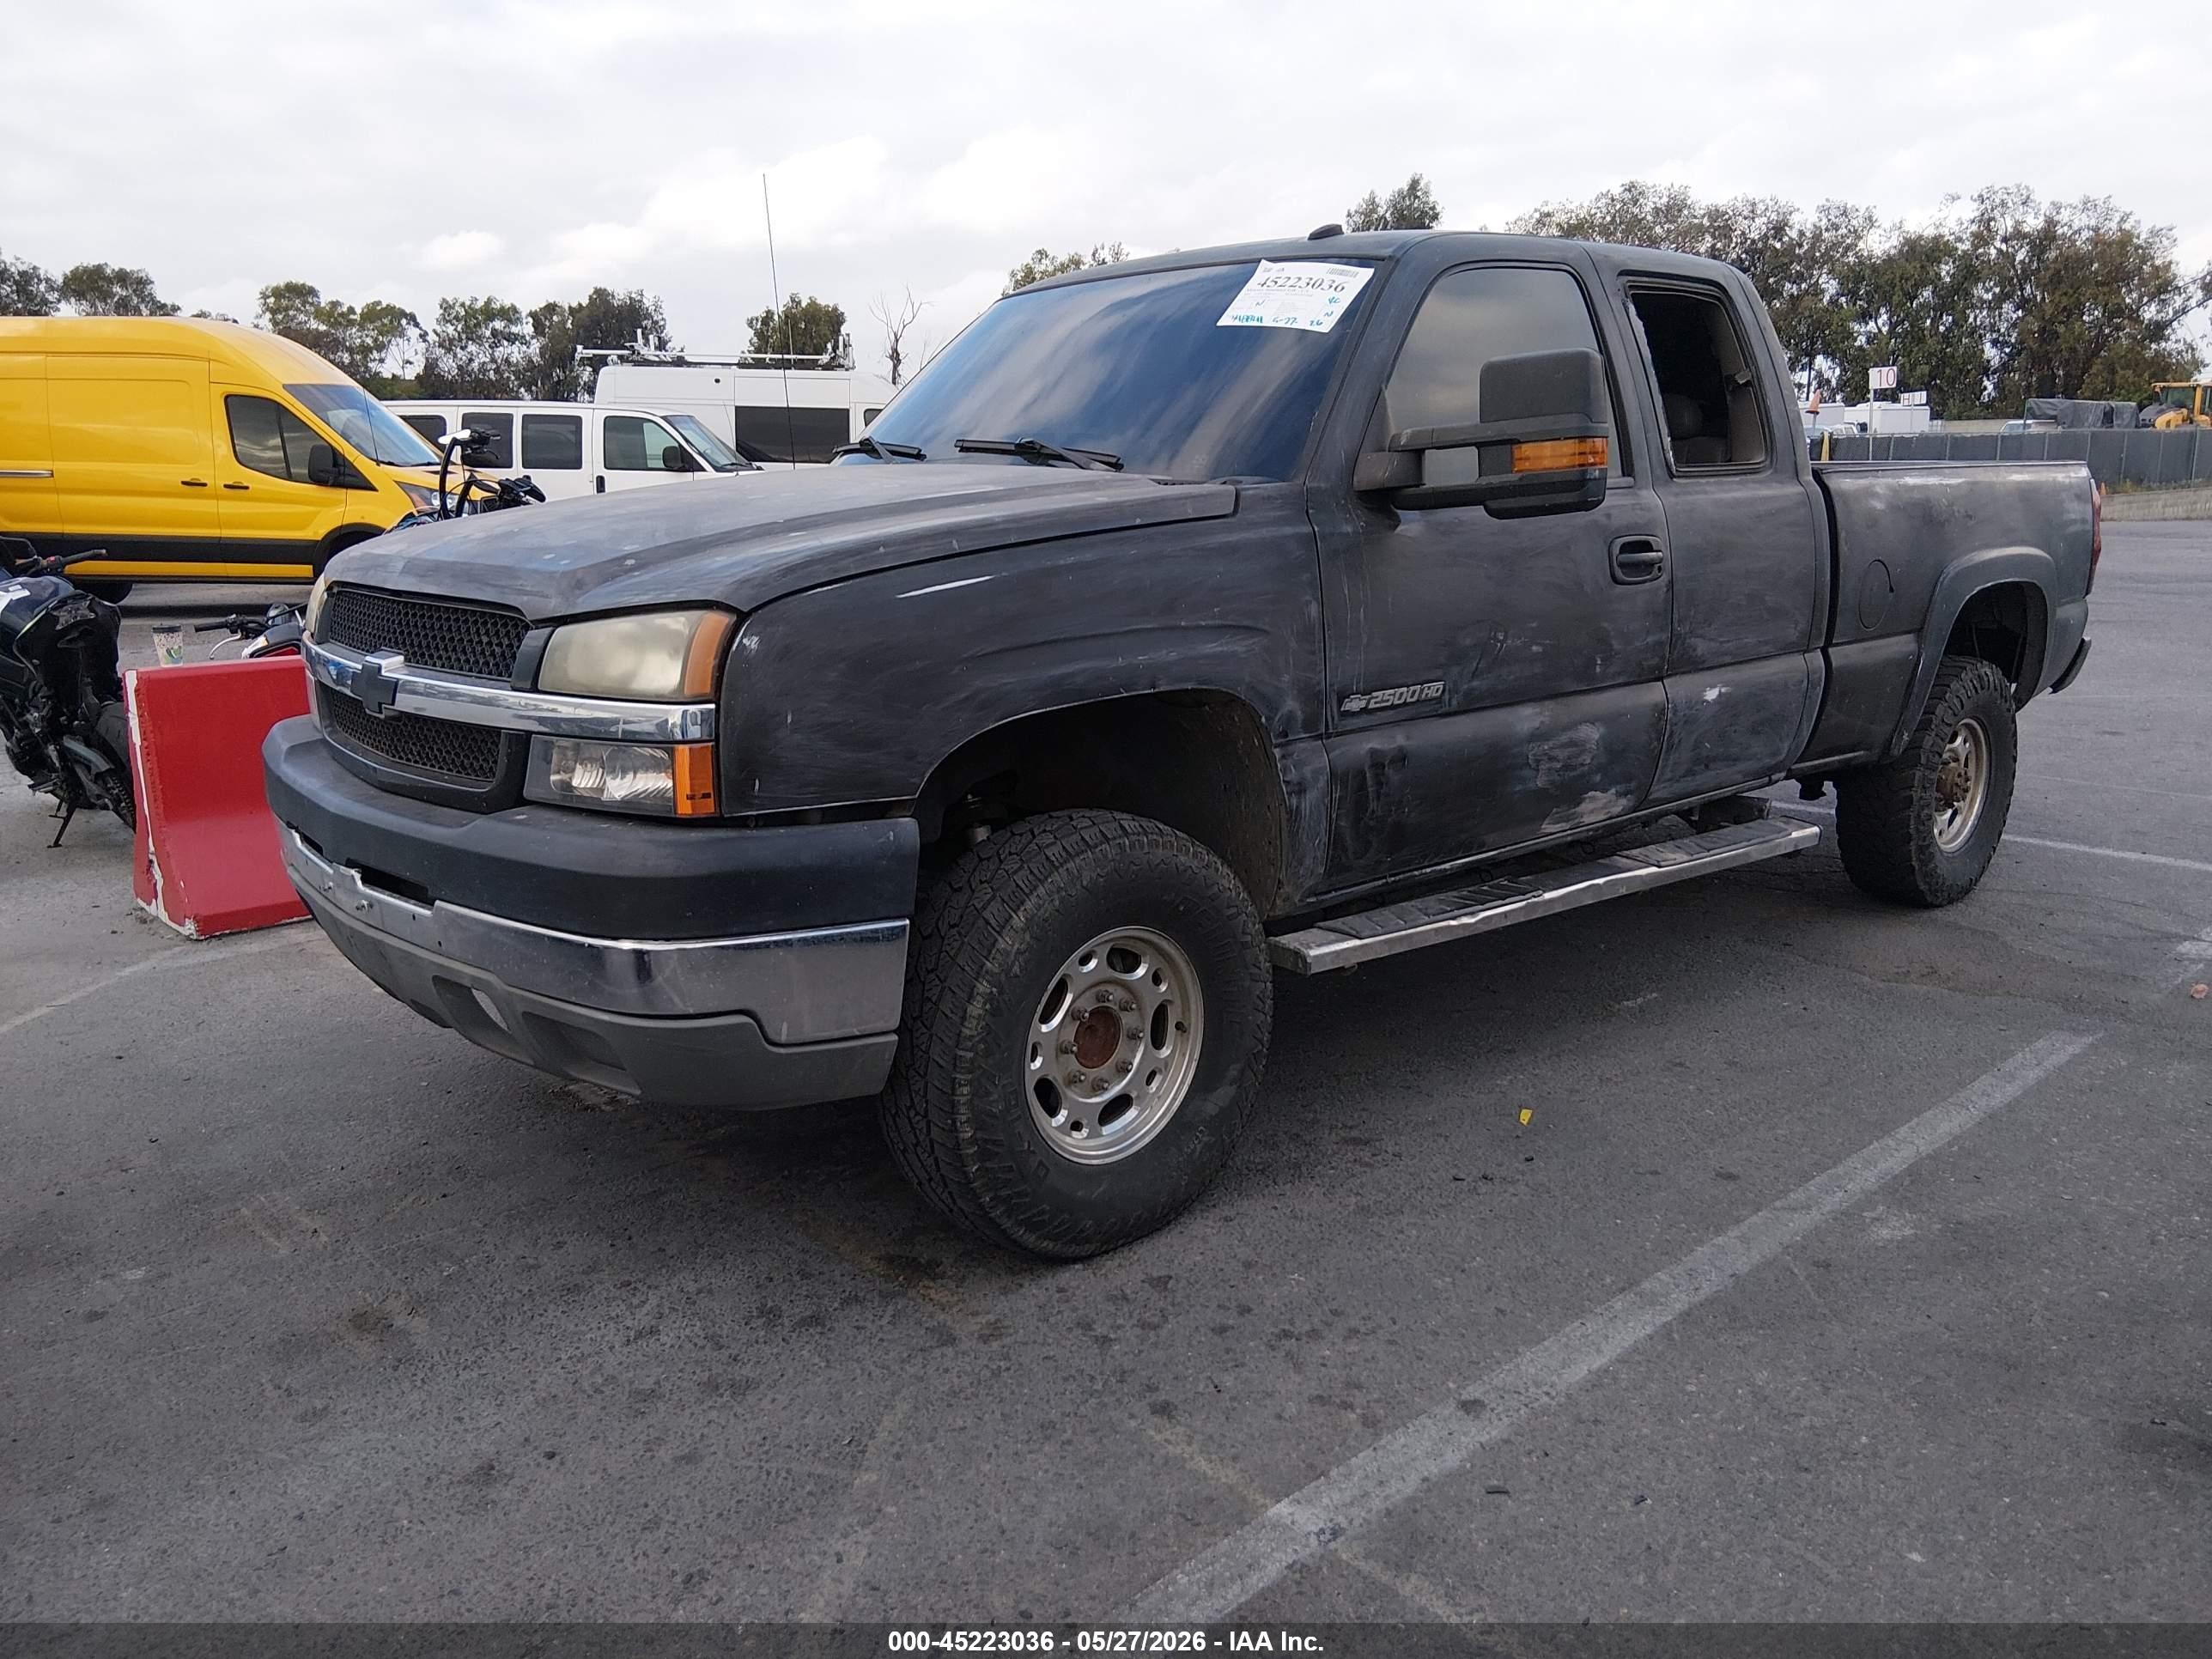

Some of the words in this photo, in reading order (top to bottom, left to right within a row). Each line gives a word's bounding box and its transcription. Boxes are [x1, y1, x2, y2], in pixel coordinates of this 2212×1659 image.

[1257, 276, 1349, 293] 45223036
[1877, 368, 1896, 387] 10
[1368, 684, 1421, 709] 2500
